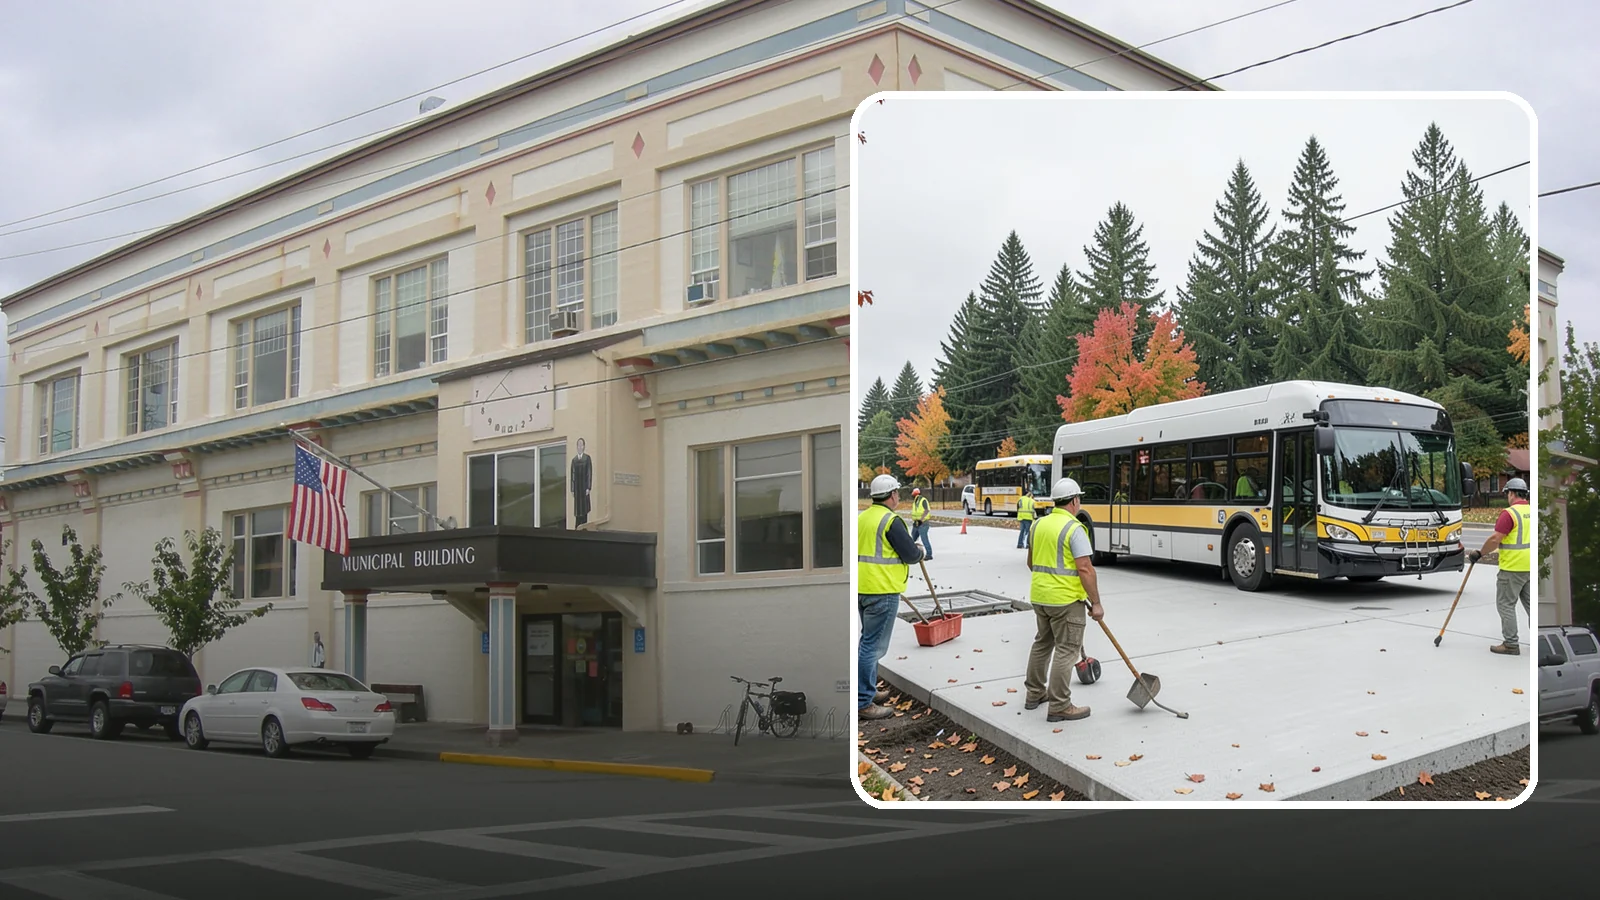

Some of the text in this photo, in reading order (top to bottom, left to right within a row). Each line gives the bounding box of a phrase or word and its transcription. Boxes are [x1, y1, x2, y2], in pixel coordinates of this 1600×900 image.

[475, 390, 479, 398] 7
[481, 407, 485, 415] 8
[488, 417, 492, 426] 9
[495, 423, 500, 432] 10
[501, 425, 506, 434] 11
[507, 425, 513, 433] 12
[521, 420, 525, 428] 2
[529, 414, 533, 422] 3
[536, 402, 540, 410] 4
[342, 546, 475, 572] MUNICIPAL BUILDING
